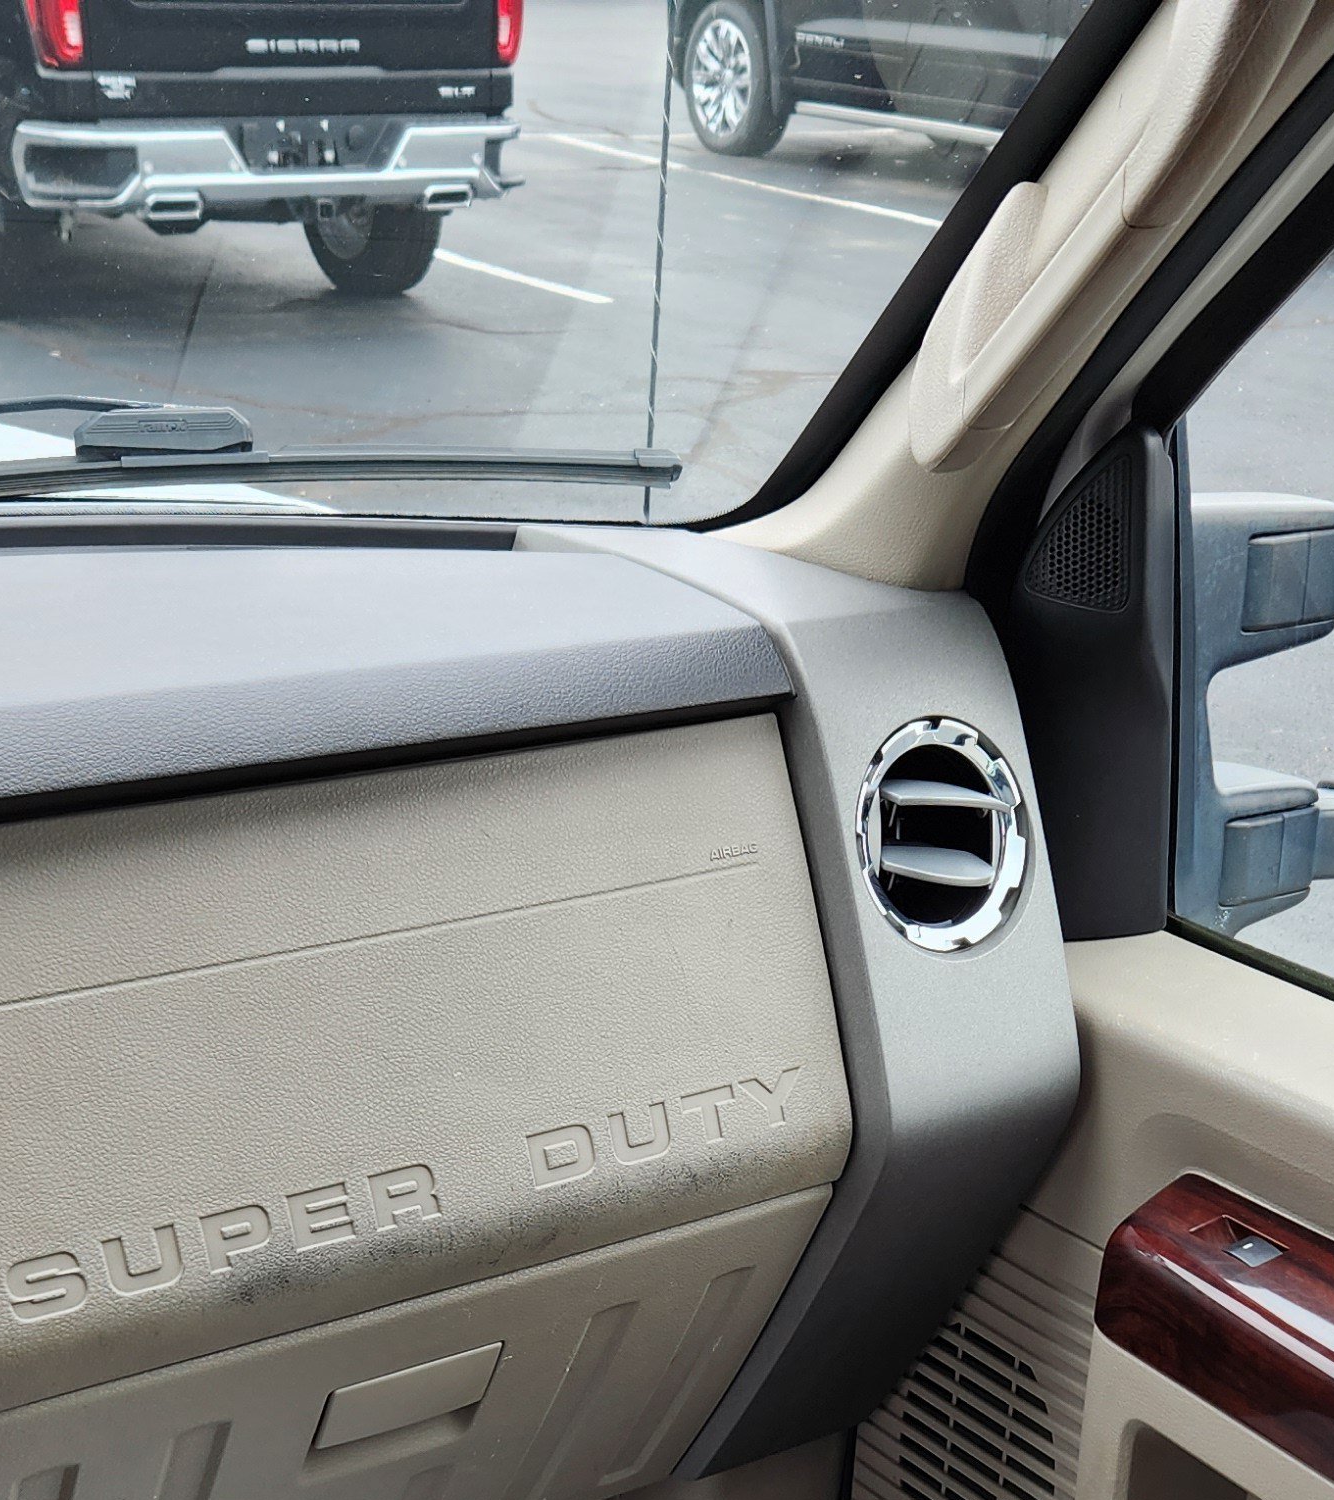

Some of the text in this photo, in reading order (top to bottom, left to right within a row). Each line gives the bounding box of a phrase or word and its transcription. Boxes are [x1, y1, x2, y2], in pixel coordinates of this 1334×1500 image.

[245, 38, 361, 55] SIERRA
[709, 843, 759, 862] AIRBAG
[5, 1065, 805, 1325] SUPER DUTY
